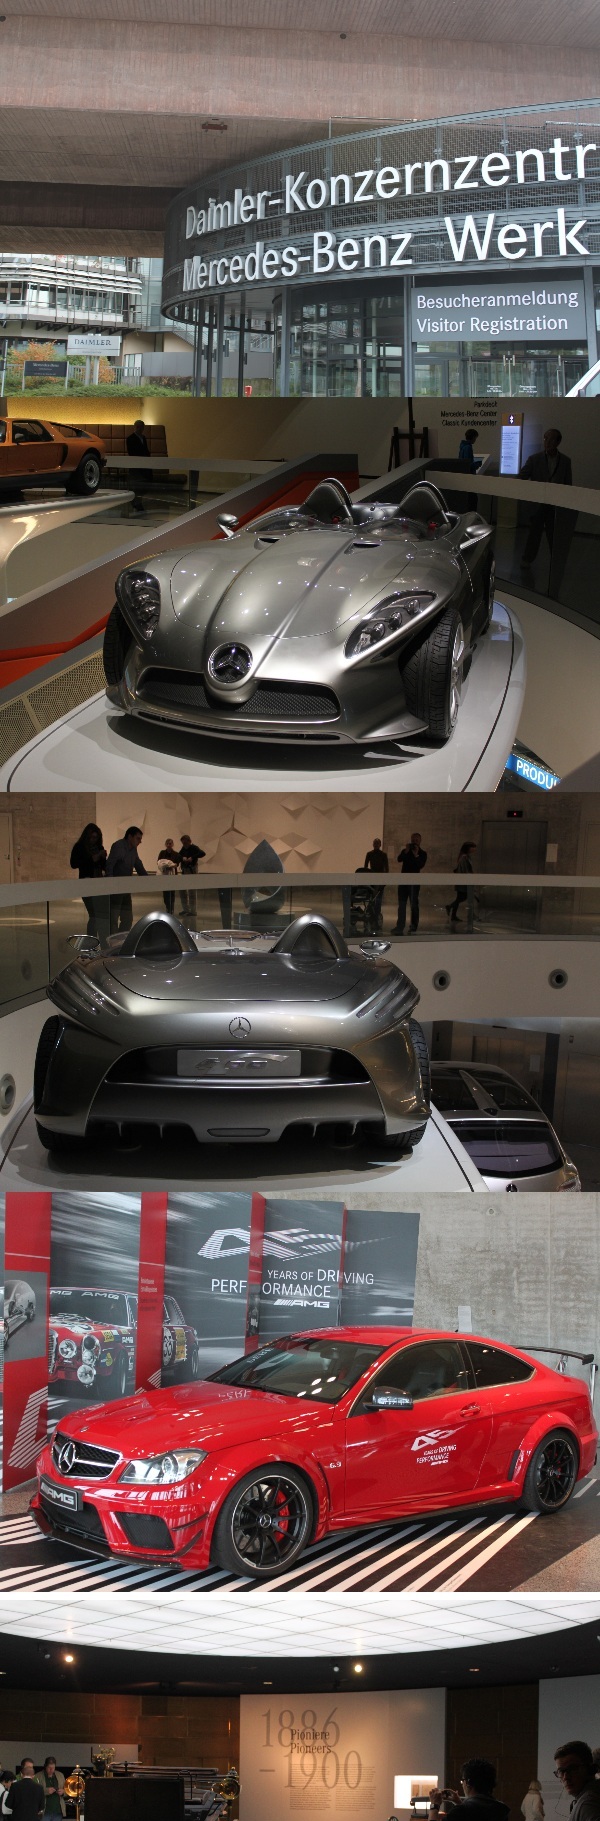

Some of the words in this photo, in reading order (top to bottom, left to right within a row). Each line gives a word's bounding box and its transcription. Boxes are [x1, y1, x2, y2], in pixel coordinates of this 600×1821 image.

[183, 231, 414, 291] Mercedes-Benz
[444, 208, 590, 261] Werk
[416, 289, 579, 309] Besucheranmeldung
[416, 317, 465, 333] Visitor
[470, 315, 568, 335] Registration
[74, 338, 111, 346] DAIMLER
[440, 410, 479, 418] Mercedes-Benz
[516, 759, 557, 789] PRODU
[267, 1270, 298, 1280] YEARS
[301, 1272, 314, 1280] OF
[261, 1706, 341, 1748] 1886
[290, 1728, 330, 1740] Pioniere
[289, 1742, 332, 1754] Pioneers
